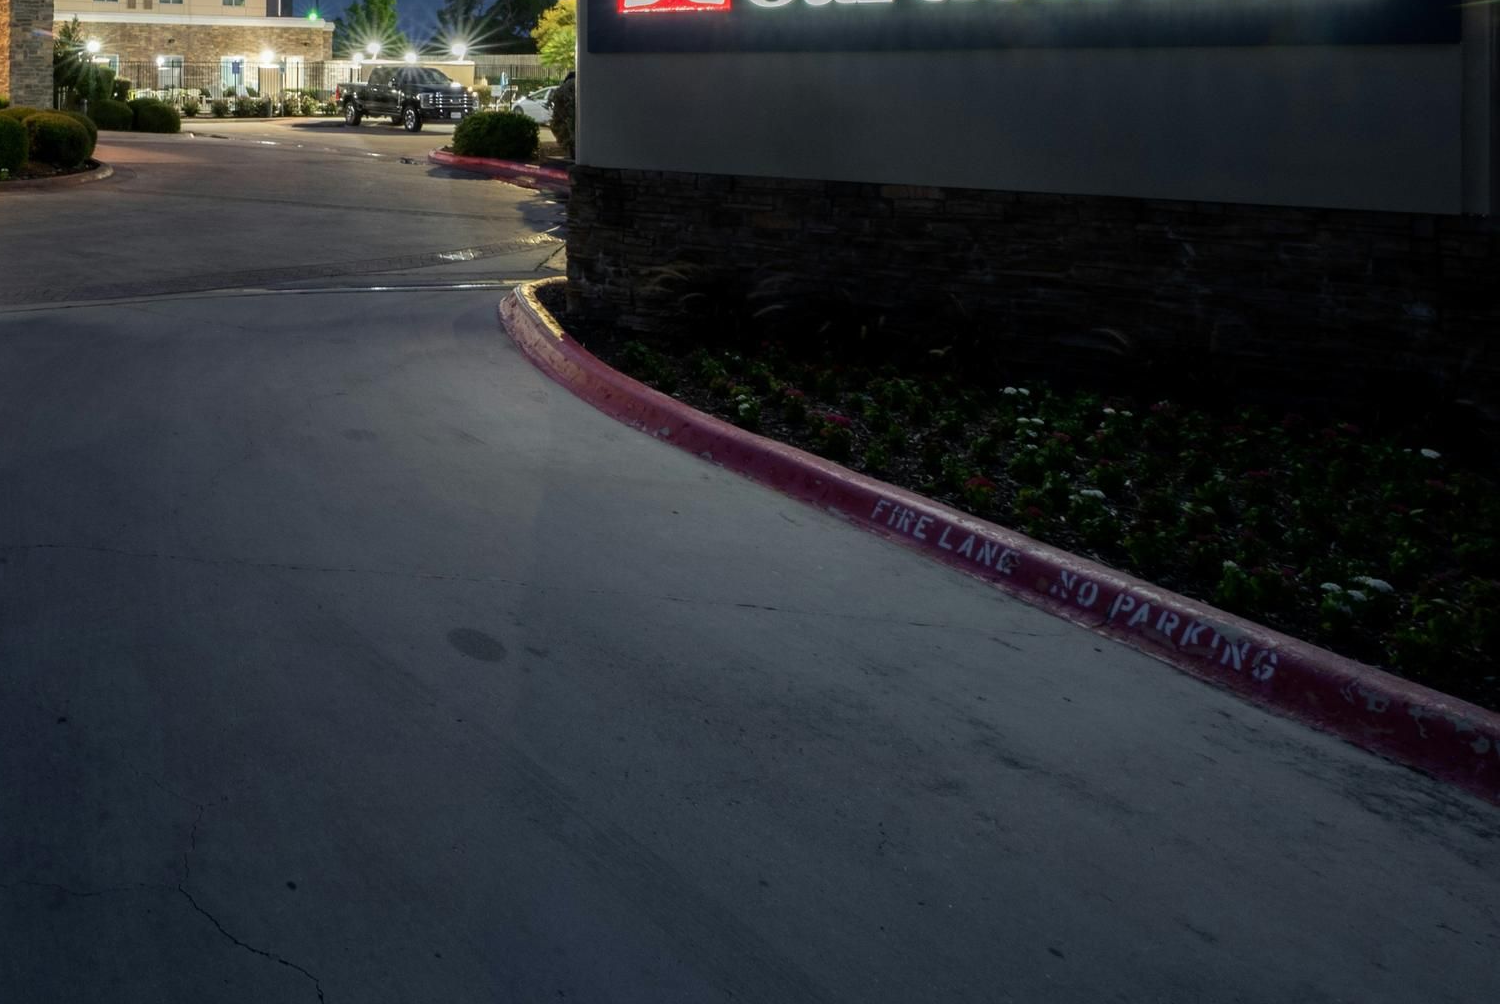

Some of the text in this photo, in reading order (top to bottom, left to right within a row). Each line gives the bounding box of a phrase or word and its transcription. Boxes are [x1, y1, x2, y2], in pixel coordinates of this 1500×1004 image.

[871, 499, 1278, 682] FIRE LANE NO PARKING
